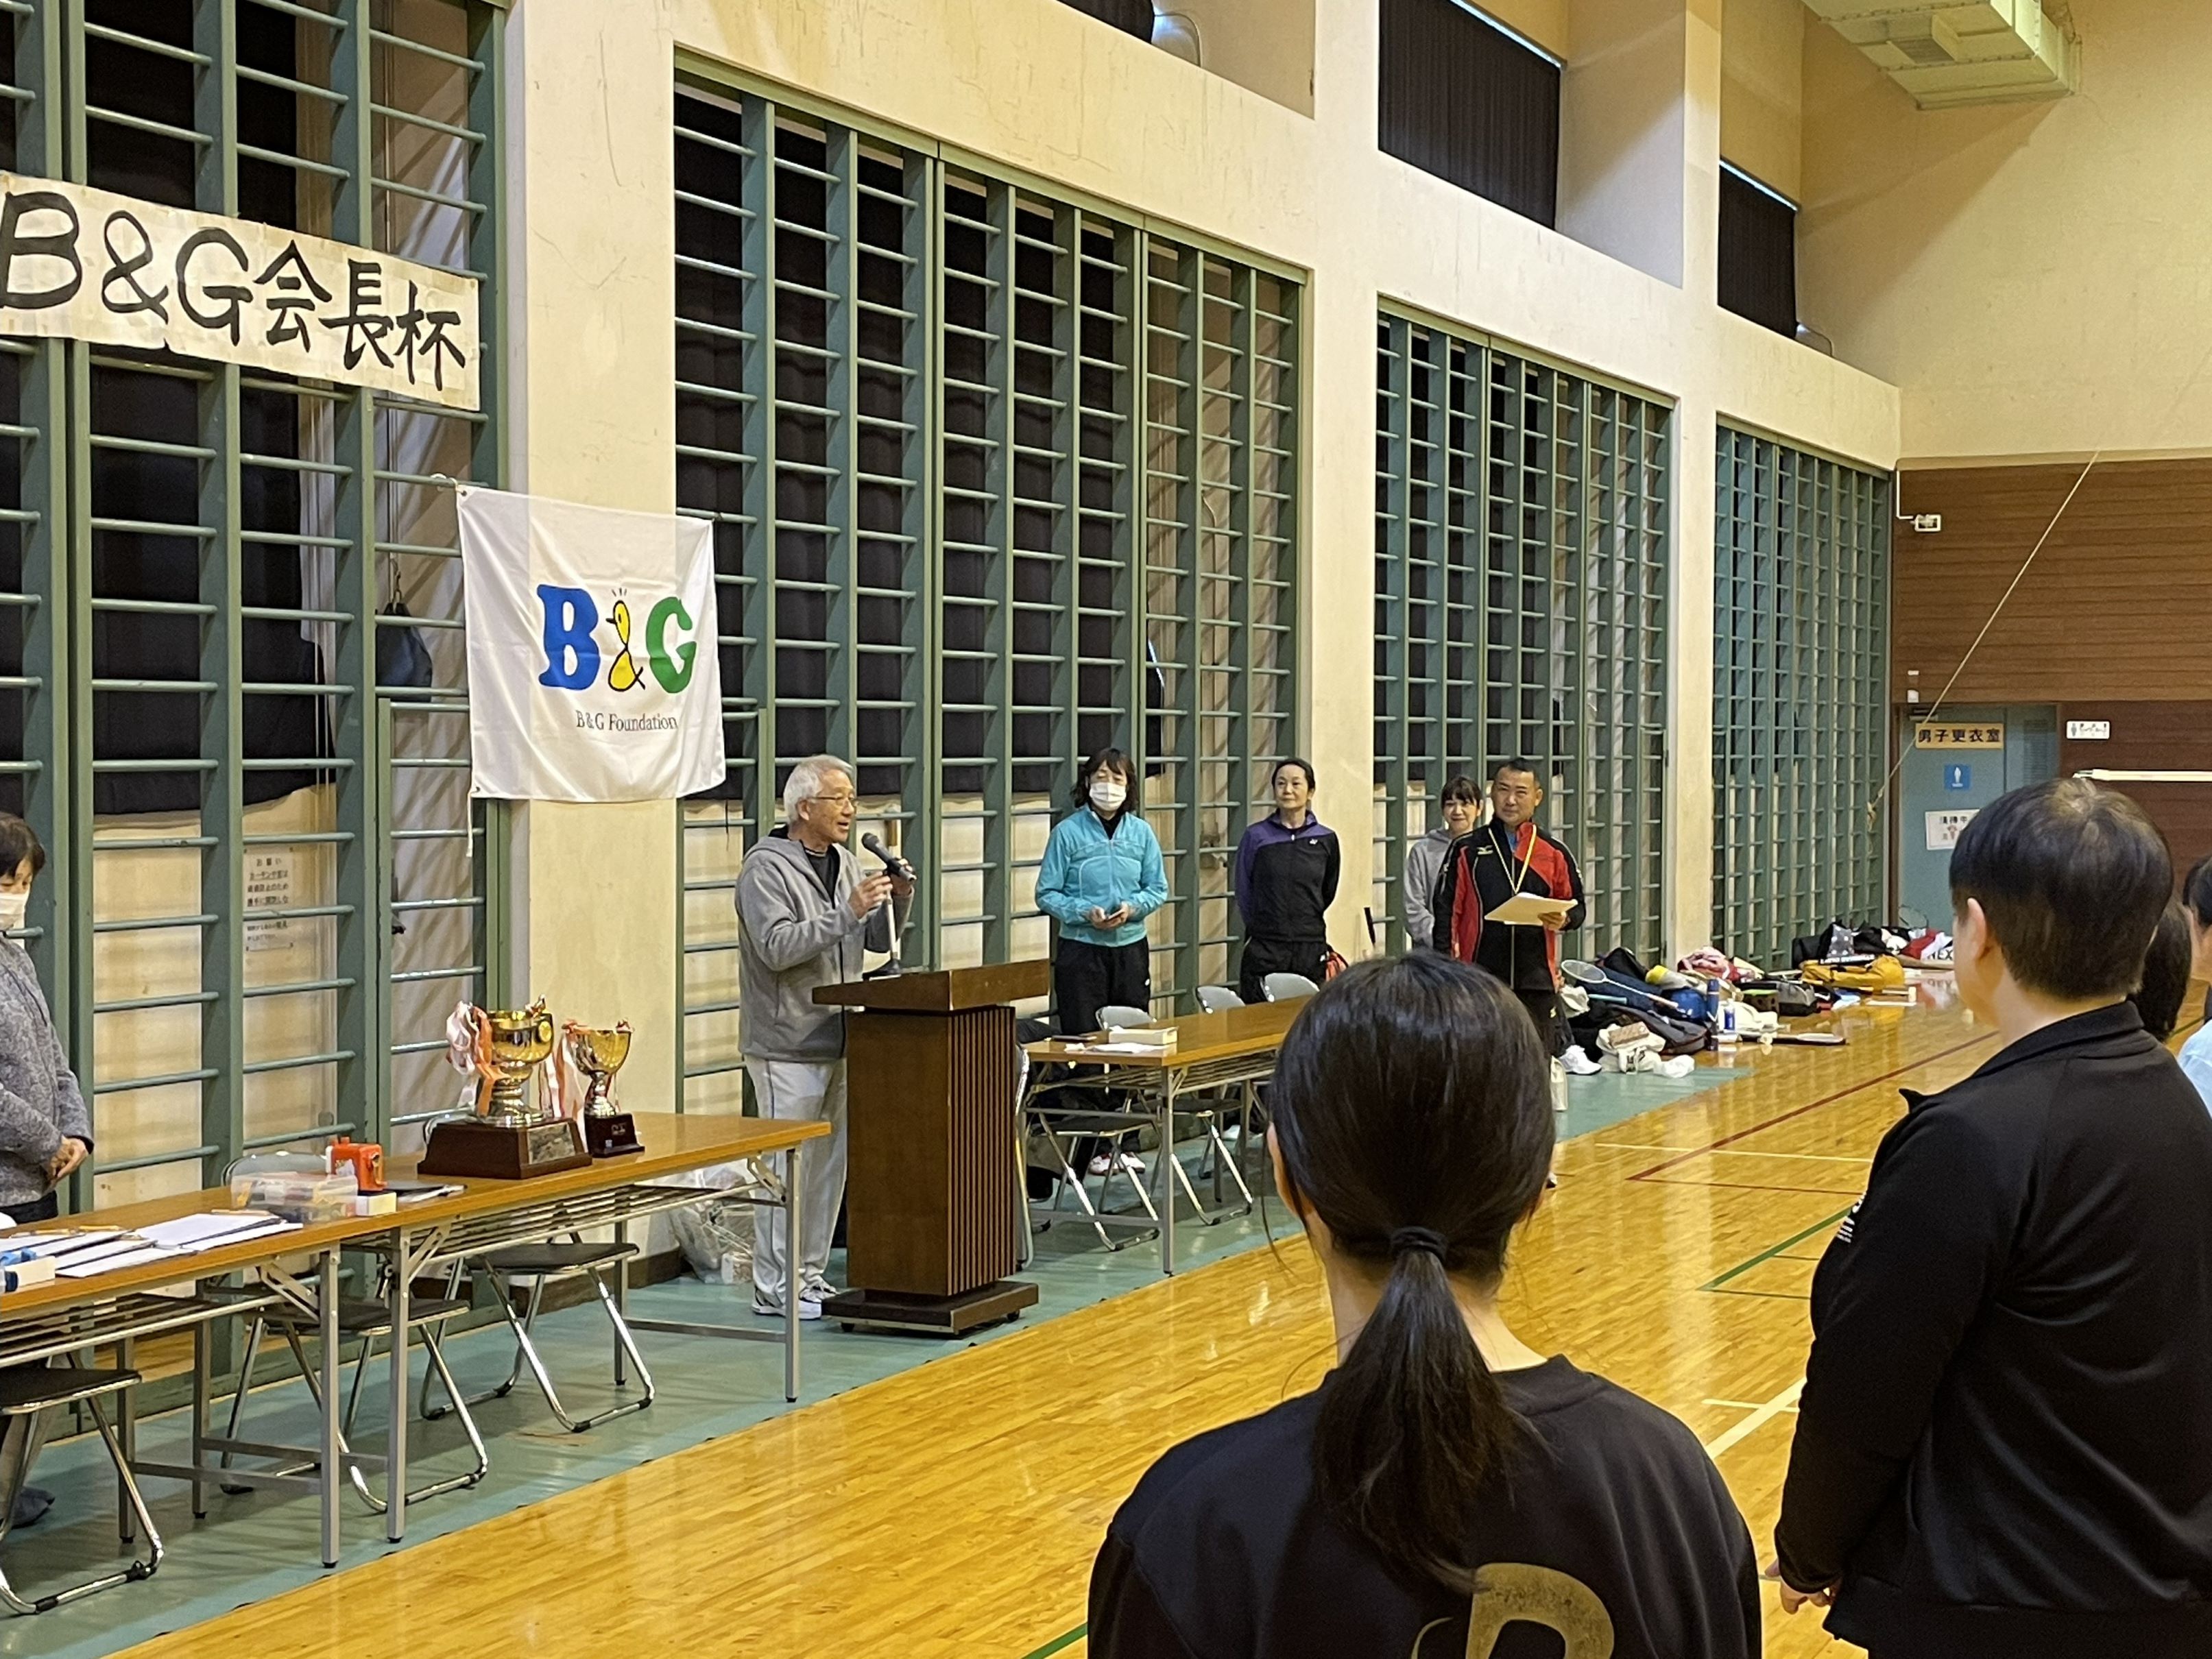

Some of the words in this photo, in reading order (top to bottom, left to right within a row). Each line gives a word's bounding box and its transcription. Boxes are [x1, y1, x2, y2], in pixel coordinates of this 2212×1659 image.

[0, 190, 466, 392] B&G会長杯
[537, 584, 697, 694] B&G
[575, 710, 605, 730] B&G
[609, 712, 678, 731] Foundation
[1918, 727, 2000, 743] 男子更衣室
